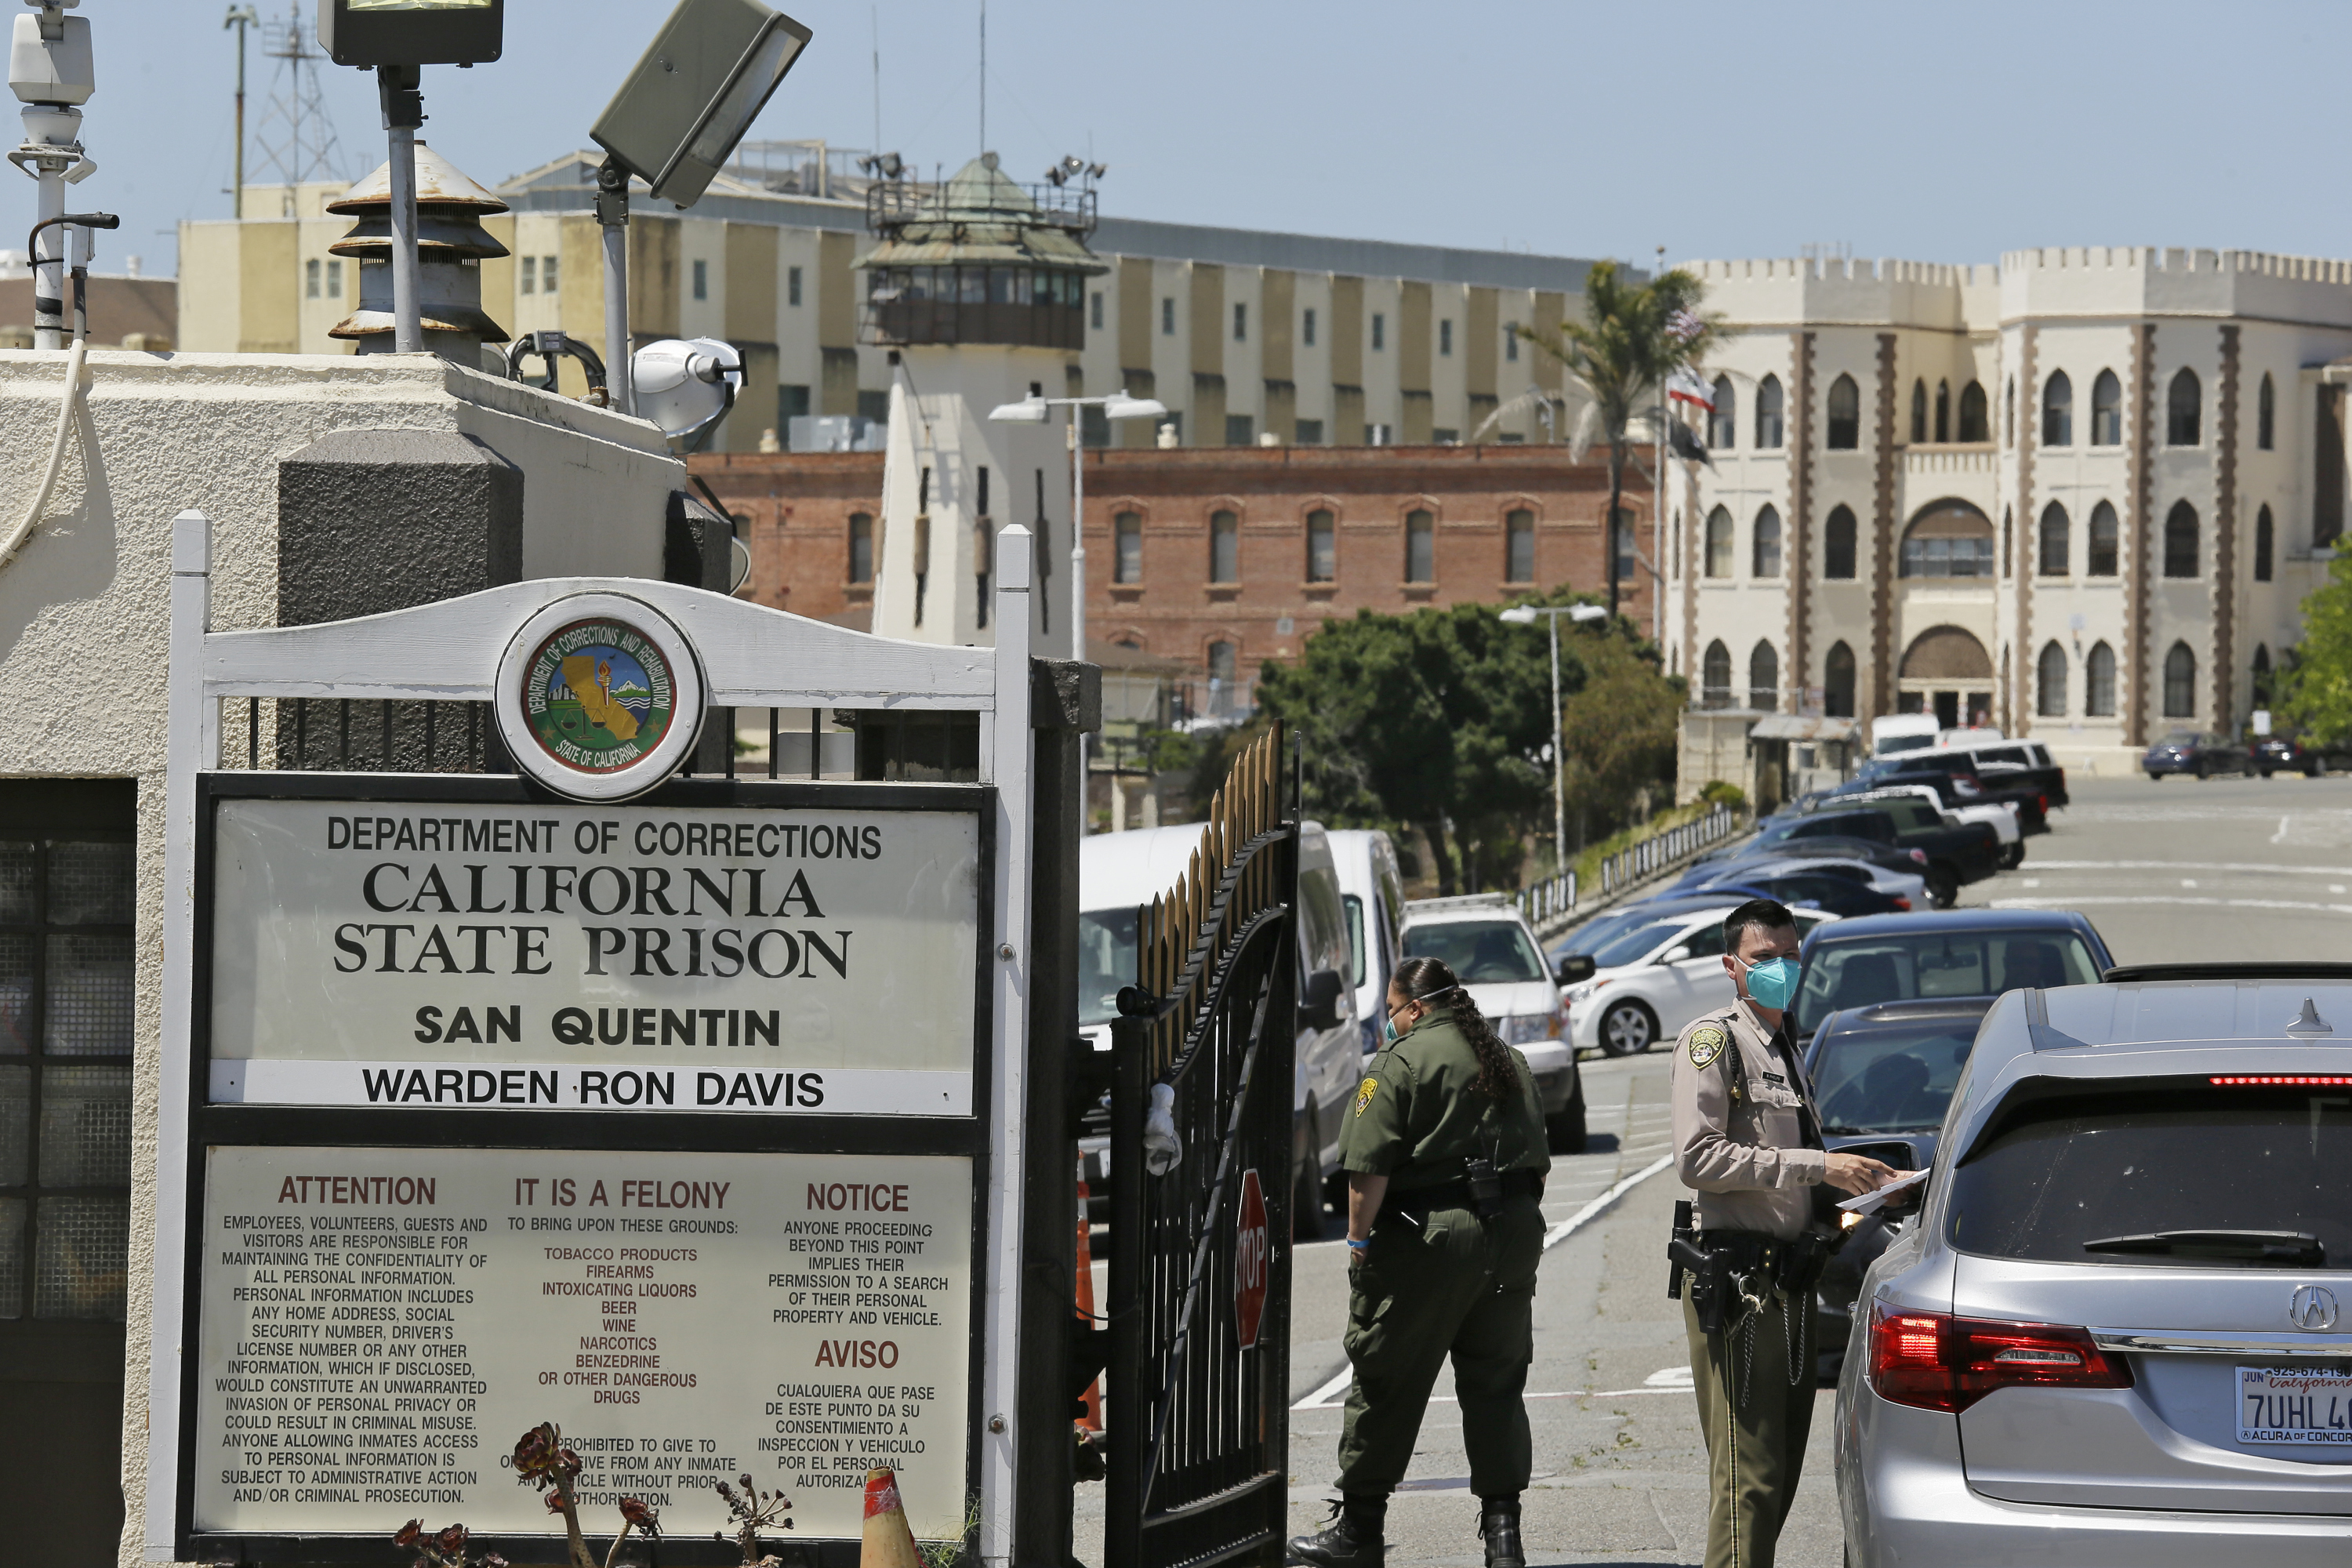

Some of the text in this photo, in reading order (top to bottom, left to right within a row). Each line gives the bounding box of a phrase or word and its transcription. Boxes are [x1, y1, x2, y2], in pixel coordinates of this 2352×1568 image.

[528, 626, 670, 715] DEPARTMENT OF CORRECTIONS AND REHABILITATION
[555, 739, 642, 768] STATE OF CALIFORNIA
[327, 815, 881, 859] DEPARTMENT OF CORRECTIONS
[362, 861, 826, 918] CALIFORNIA
[333, 923, 853, 979] STATE PRISON
[414, 1004, 779, 1047] SAN QUENTIN
[362, 1069, 825, 1108] WARDEN RON DAVIS
[277, 1175, 435, 1205] ATTENTION
[515, 1178, 731, 1209] IT IS A FELONY
[807, 1182, 909, 1211] NOTICE
[223, 1215, 487, 1233] EMPLOYEES, VOLUNTEERS, GUESTS AND
[507, 1217, 738, 1233] TO BRING UPON THESE GROUNDS:
[783, 1221, 932, 1237] ANYONE PROCEEDING
[242, 1233, 467, 1249] VISITORS ARE RESPONSIBLE FOR
[789, 1238, 924, 1254] BEYOND THIS POINT
[222, 1251, 487, 1268] MAINTAINING THE CONFIDENTIALITY OF
[543, 1247, 697, 1261] TOBACCO PRODUCTS
[1237, 1226, 1265, 1293] STOP
[586, 1264, 654, 1279] FIREARMS
[808, 1256, 903, 1272] IMPLIES THEIR
[252, 1269, 455, 1285] ALL PERSONAL INFORMATION.
[768, 1273, 948, 1290] PERMISSION TO A SEARCH
[233, 1287, 473, 1303] PERSONAL INFORMATION INCLUDES
[543, 1281, 696, 1298] INTOXICATING LIQUORS
[601, 1300, 637, 1314] BEER
[788, 1291, 927, 1308] OF THEIR PERSONAL
[251, 1305, 455, 1323] ANY HOME ADDRESS, SOCIAL
[773, 1308, 942, 1326] PROPERTY AND VEHICLE.
[252, 1323, 453, 1341] SECURITY NUMBER, DRIVER'S
[602, 1318, 636, 1332] WINE
[237, 1341, 466, 1358] LICENSE NUMBER OR ANY OTHER
[580, 1336, 656, 1351] NARCOTICS
[575, 1354, 660, 1368] BENZEDRINE
[814, 1339, 898, 1369] AVISO
[227, 1359, 474, 1378] INFORMATION, WHICH IF DISCLOSED,
[215, 1377, 487, 1394] WOULD CONSTITUTE AN UNWARRANTED
[538, 1371, 696, 1388] OR OTHER DANGEROUS
[2244, 1372, 2264, 1383] JUN
[593, 1389, 640, 1404] DRUGS
[776, 1383, 935, 1399] CUALQUIERA QUE PASE
[226, 1396, 476, 1411] INVASION OF PERSONAL PRIVACY OR
[765, 1402, 920, 1417] DE ESTE PUNTO DA SU
[775, 1419, 908, 1435] CONSENTIMIENTO A
[221, 1433, 477, 1448] ANYONE ALLOWING INMATES ACCESS
[2251, 1430, 2292, 1441] ACURA
[557, 1438, 717, 1453] PROHIBITED TO GIVE TO
[757, 1437, 924, 1454] INSPECCION Y VEHICULO
[611, 1456, 649, 1469] FROM
[654, 1457, 684, 1470] ANY
[688, 1457, 737, 1471] INMATE
[778, 1456, 905, 1471] POR EL PERSONAL
[220, 1469, 477, 1484] SUBJECT TO ADMINISTRATIVE ACTION
[612, 1474, 673, 1488] WITHOUT
[677, 1475, 718, 1489] PRIOR
[796, 1475, 867, 1488] AUTORIZA
[233, 1486, 463, 1503] AND/OR CRIMINAL PROSECUTION.
